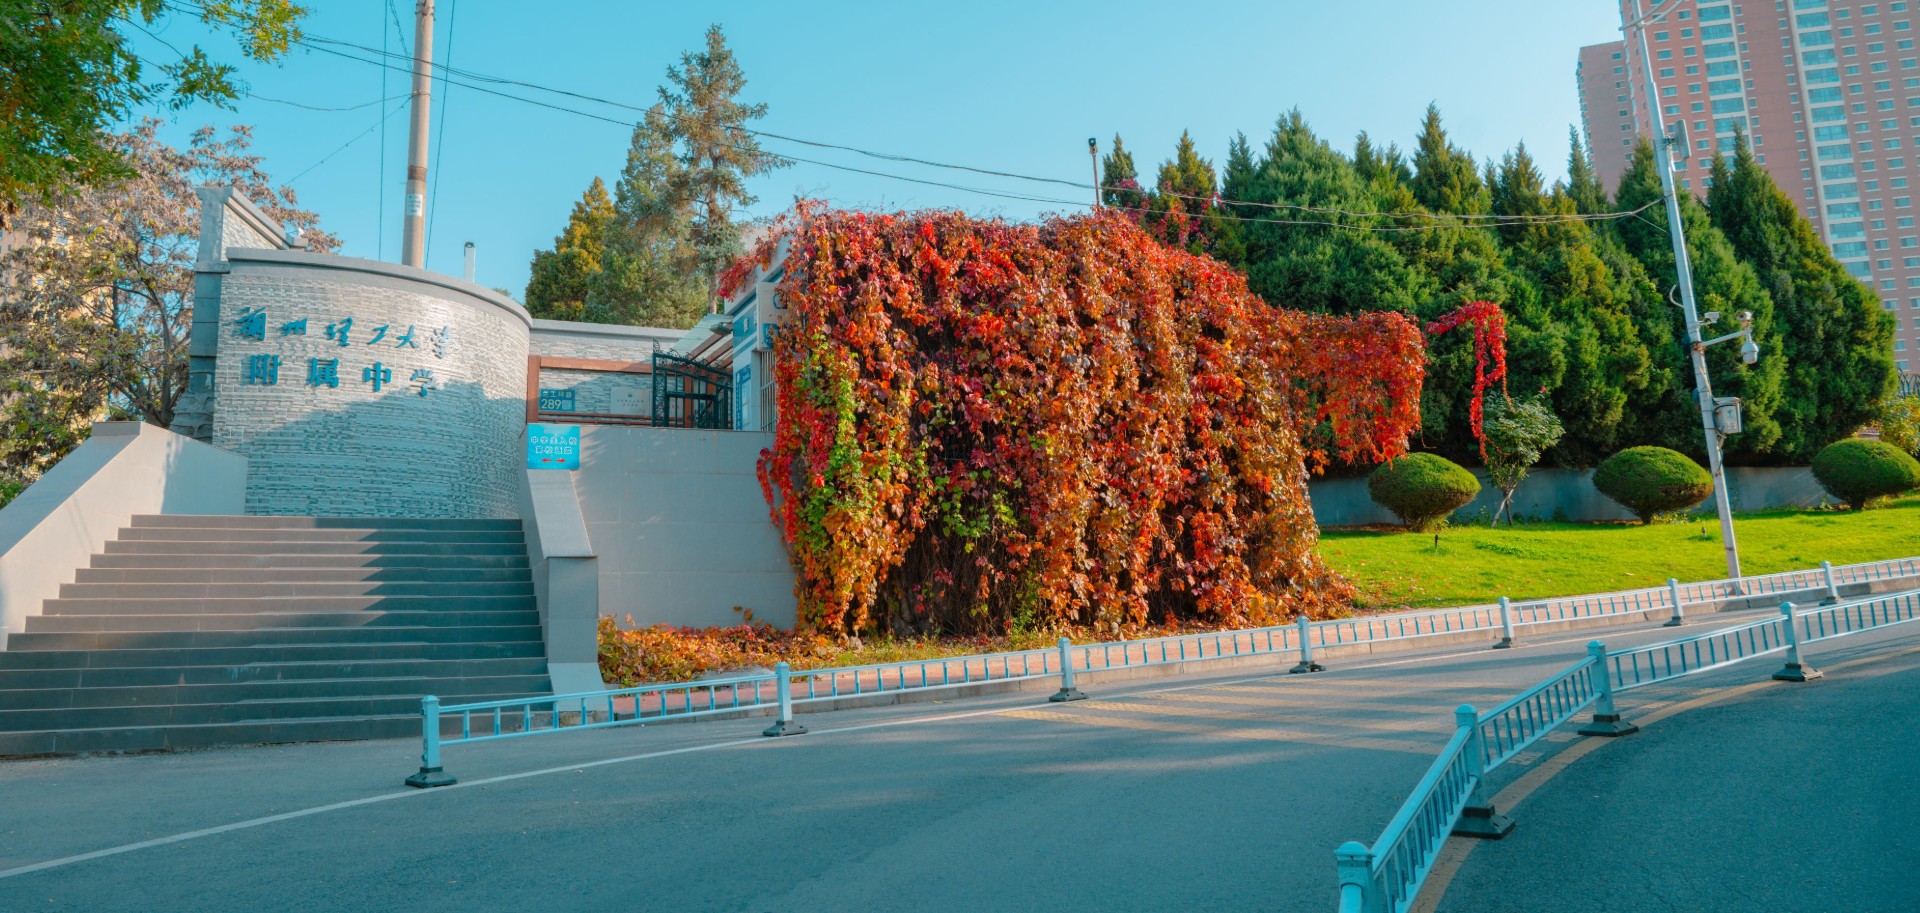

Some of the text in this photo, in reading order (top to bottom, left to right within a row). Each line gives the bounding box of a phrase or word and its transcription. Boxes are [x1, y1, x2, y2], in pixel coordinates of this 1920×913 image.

[249, 353, 436, 397] 附属中学
[541, 399, 562, 410] 289
